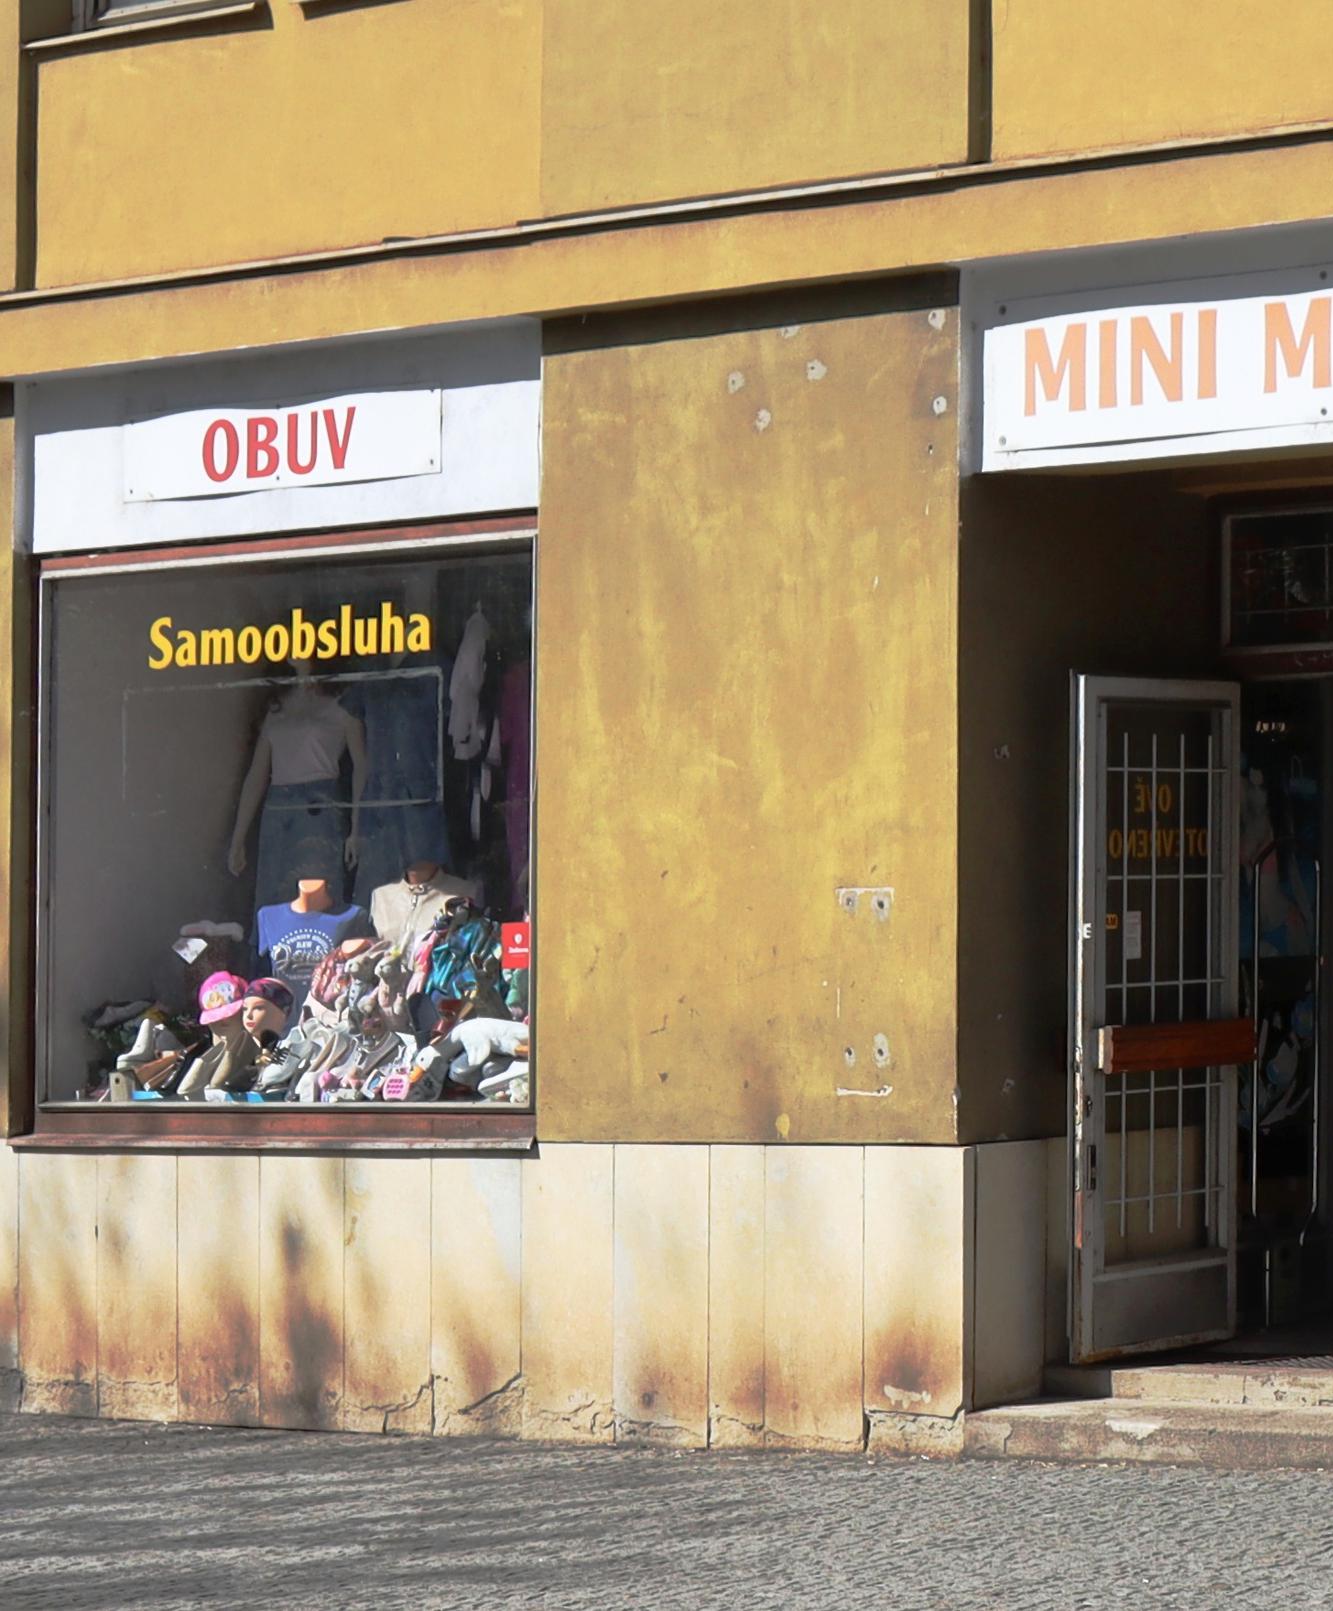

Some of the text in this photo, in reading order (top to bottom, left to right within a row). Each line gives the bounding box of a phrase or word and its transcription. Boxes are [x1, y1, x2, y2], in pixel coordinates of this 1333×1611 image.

[1024, 308, 1218, 416] MINI
[202, 406, 356, 482] OBUV
[149, 602, 431, 669] Samoobsluha
